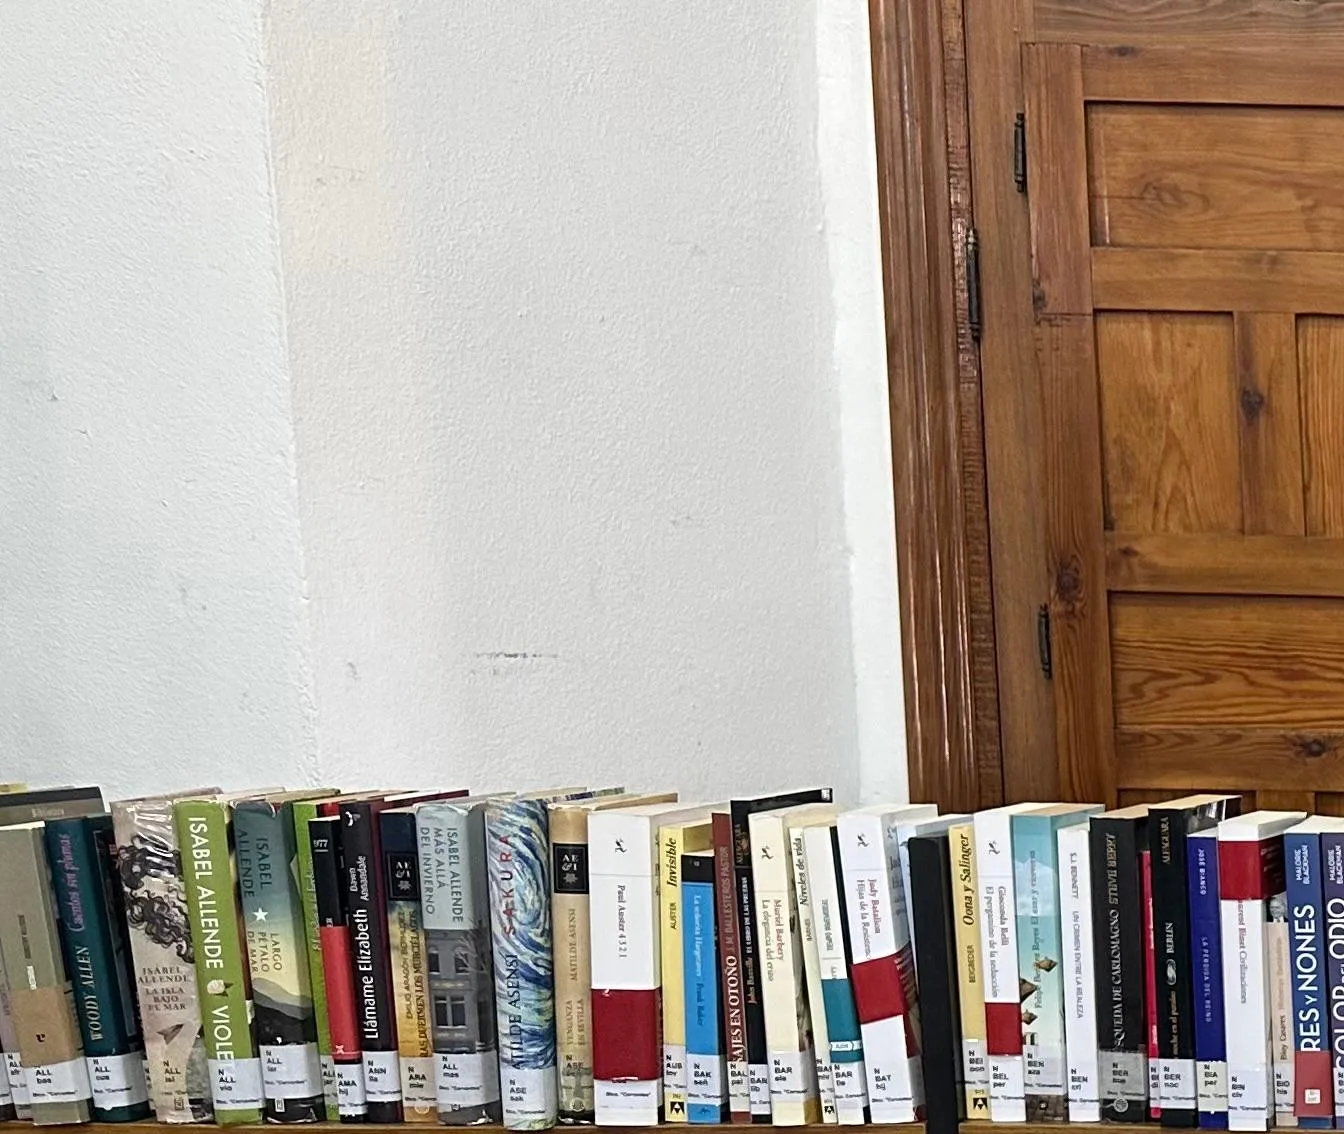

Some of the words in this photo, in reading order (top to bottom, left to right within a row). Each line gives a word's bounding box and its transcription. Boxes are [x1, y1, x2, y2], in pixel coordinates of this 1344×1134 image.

[188, 817, 211, 878] ISABEL
[667, 838, 677, 887] Invisible
[498, 835, 515, 935] SAKURA
[197, 885, 224, 969] ALLENDE
[355, 909, 372, 971] Elizabeth
[1293, 904, 1319, 992] NONES
[359, 977, 380, 1039] Llámame
